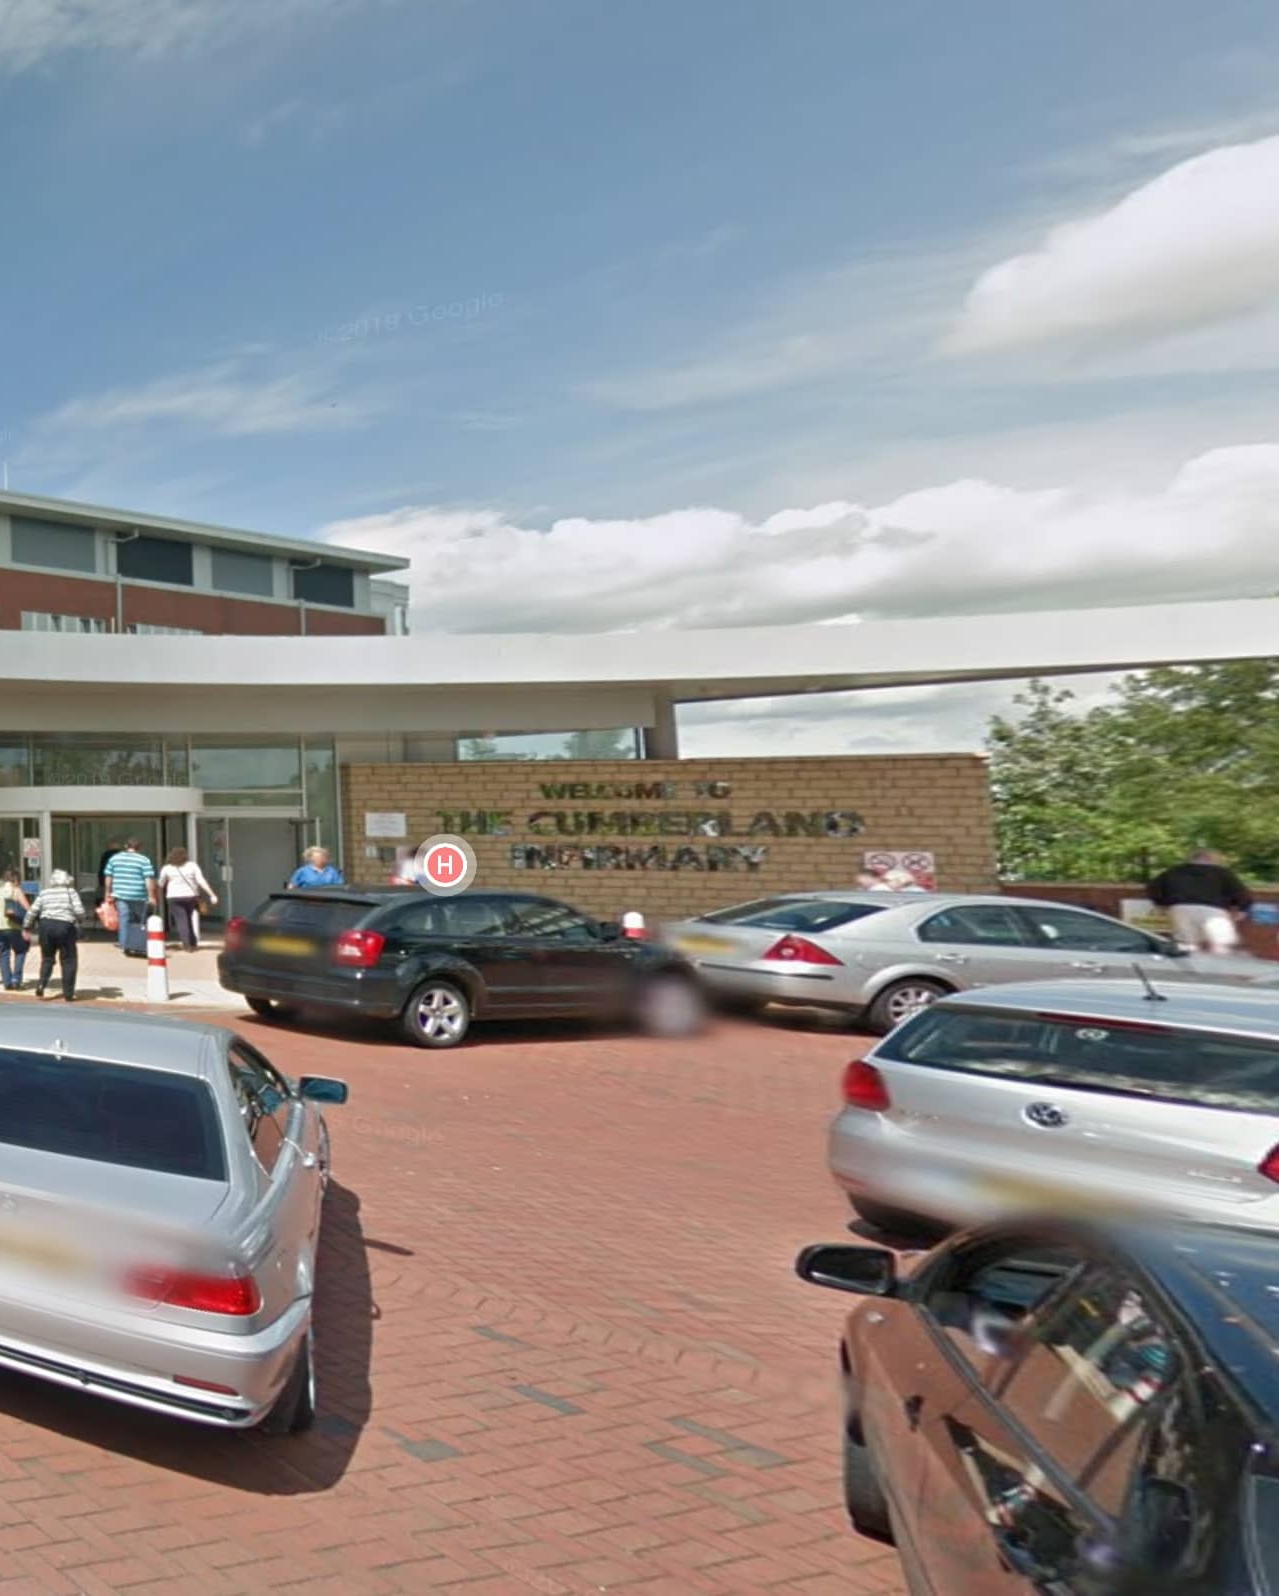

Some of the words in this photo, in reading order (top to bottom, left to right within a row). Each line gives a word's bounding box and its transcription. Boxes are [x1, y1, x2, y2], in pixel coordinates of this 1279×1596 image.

[435, 810, 512, 836] THE
[528, 810, 867, 838] CUMBERLAND
[510, 844, 769, 871] INFIRMARY
